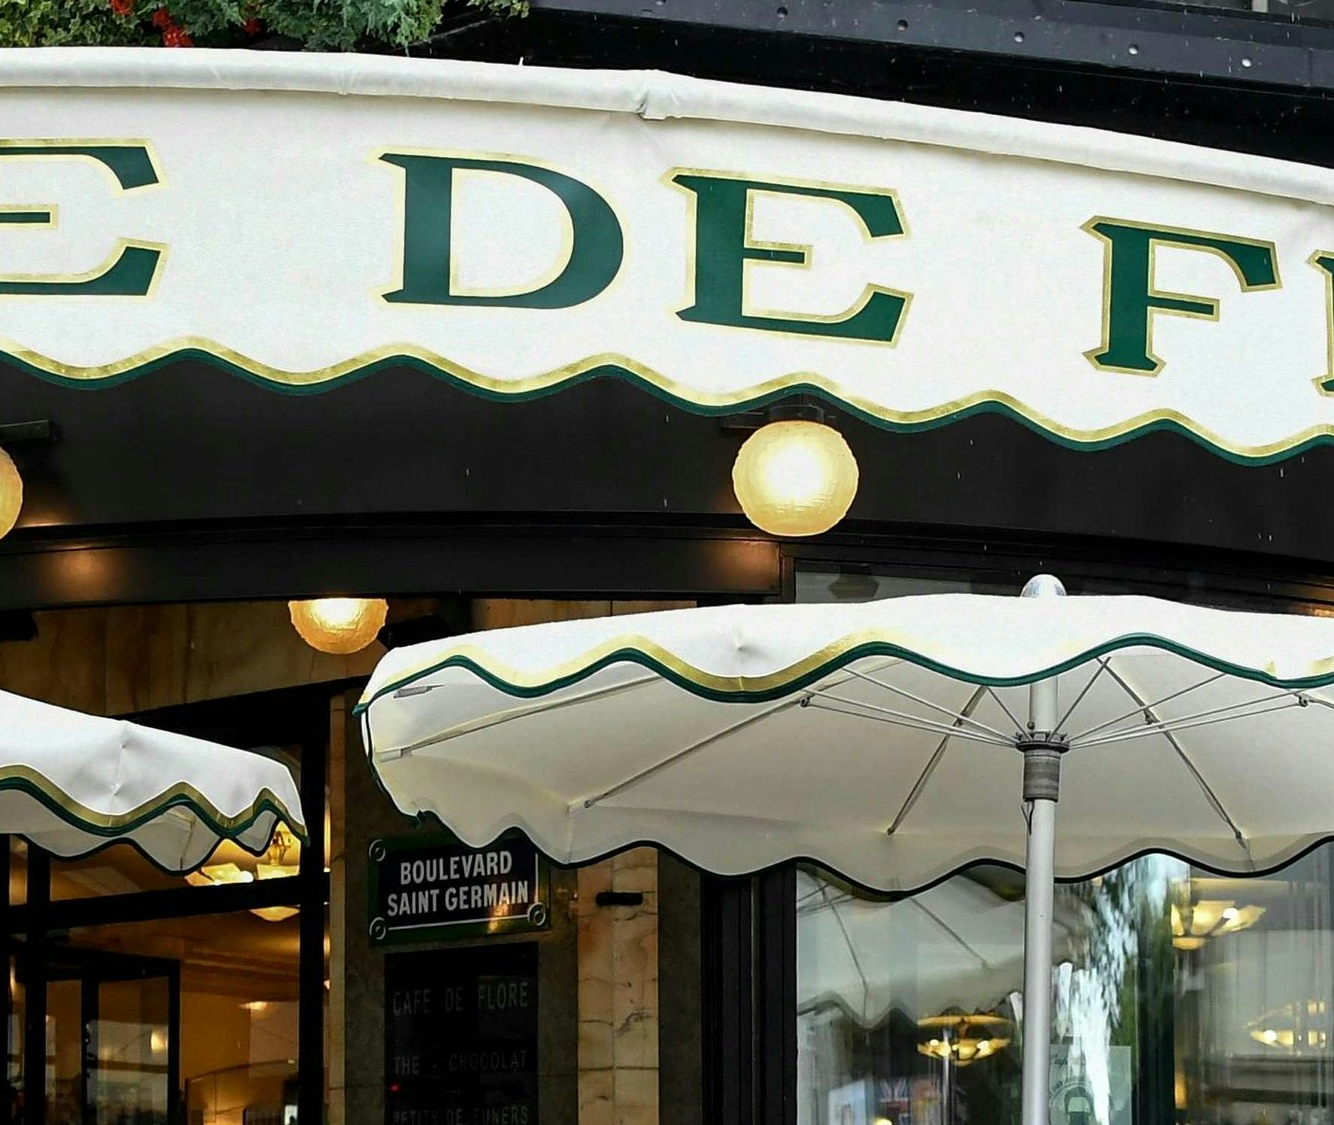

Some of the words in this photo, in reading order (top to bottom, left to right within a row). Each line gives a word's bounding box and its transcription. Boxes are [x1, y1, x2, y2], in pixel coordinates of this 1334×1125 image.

[375, 147, 913, 347] DE
[400, 851, 512, 885] BOULEVARD
[387, 889, 439, 916] SAINT
[445, 880, 528, 911] GERMAIN
[445, 986, 464, 1012] DE
[477, 982, 528, 1010] FLORE
[450, 1050, 527, 1071] CHOCOLAT
